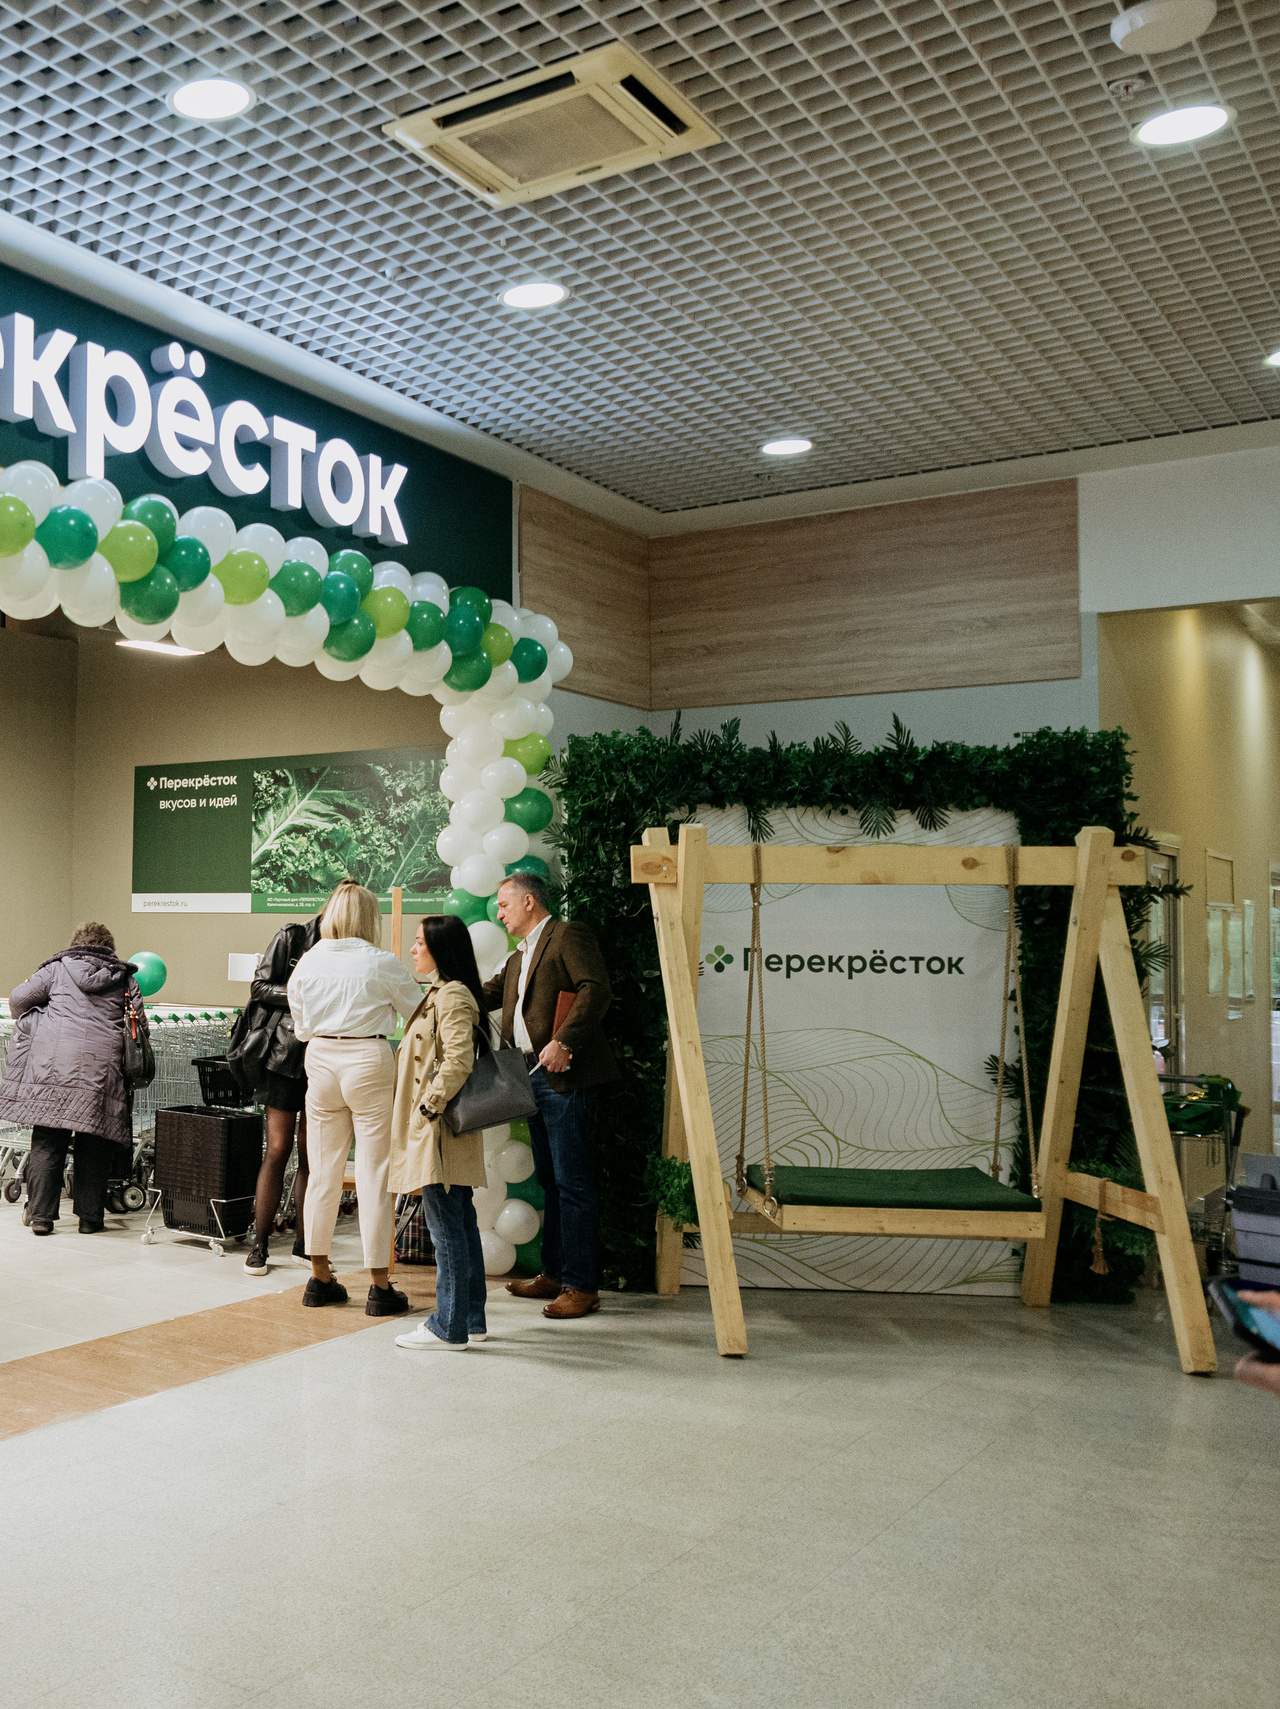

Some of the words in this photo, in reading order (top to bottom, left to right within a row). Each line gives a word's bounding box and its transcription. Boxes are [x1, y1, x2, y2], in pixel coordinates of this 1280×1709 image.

[159, 775, 238, 791] Перекрёсток
[159, 798, 197, 811] вкусов
[199, 798, 207, 808] и
[209, 795, 238, 809] идей
[143, 900, 188, 908] perekrestok.ru
